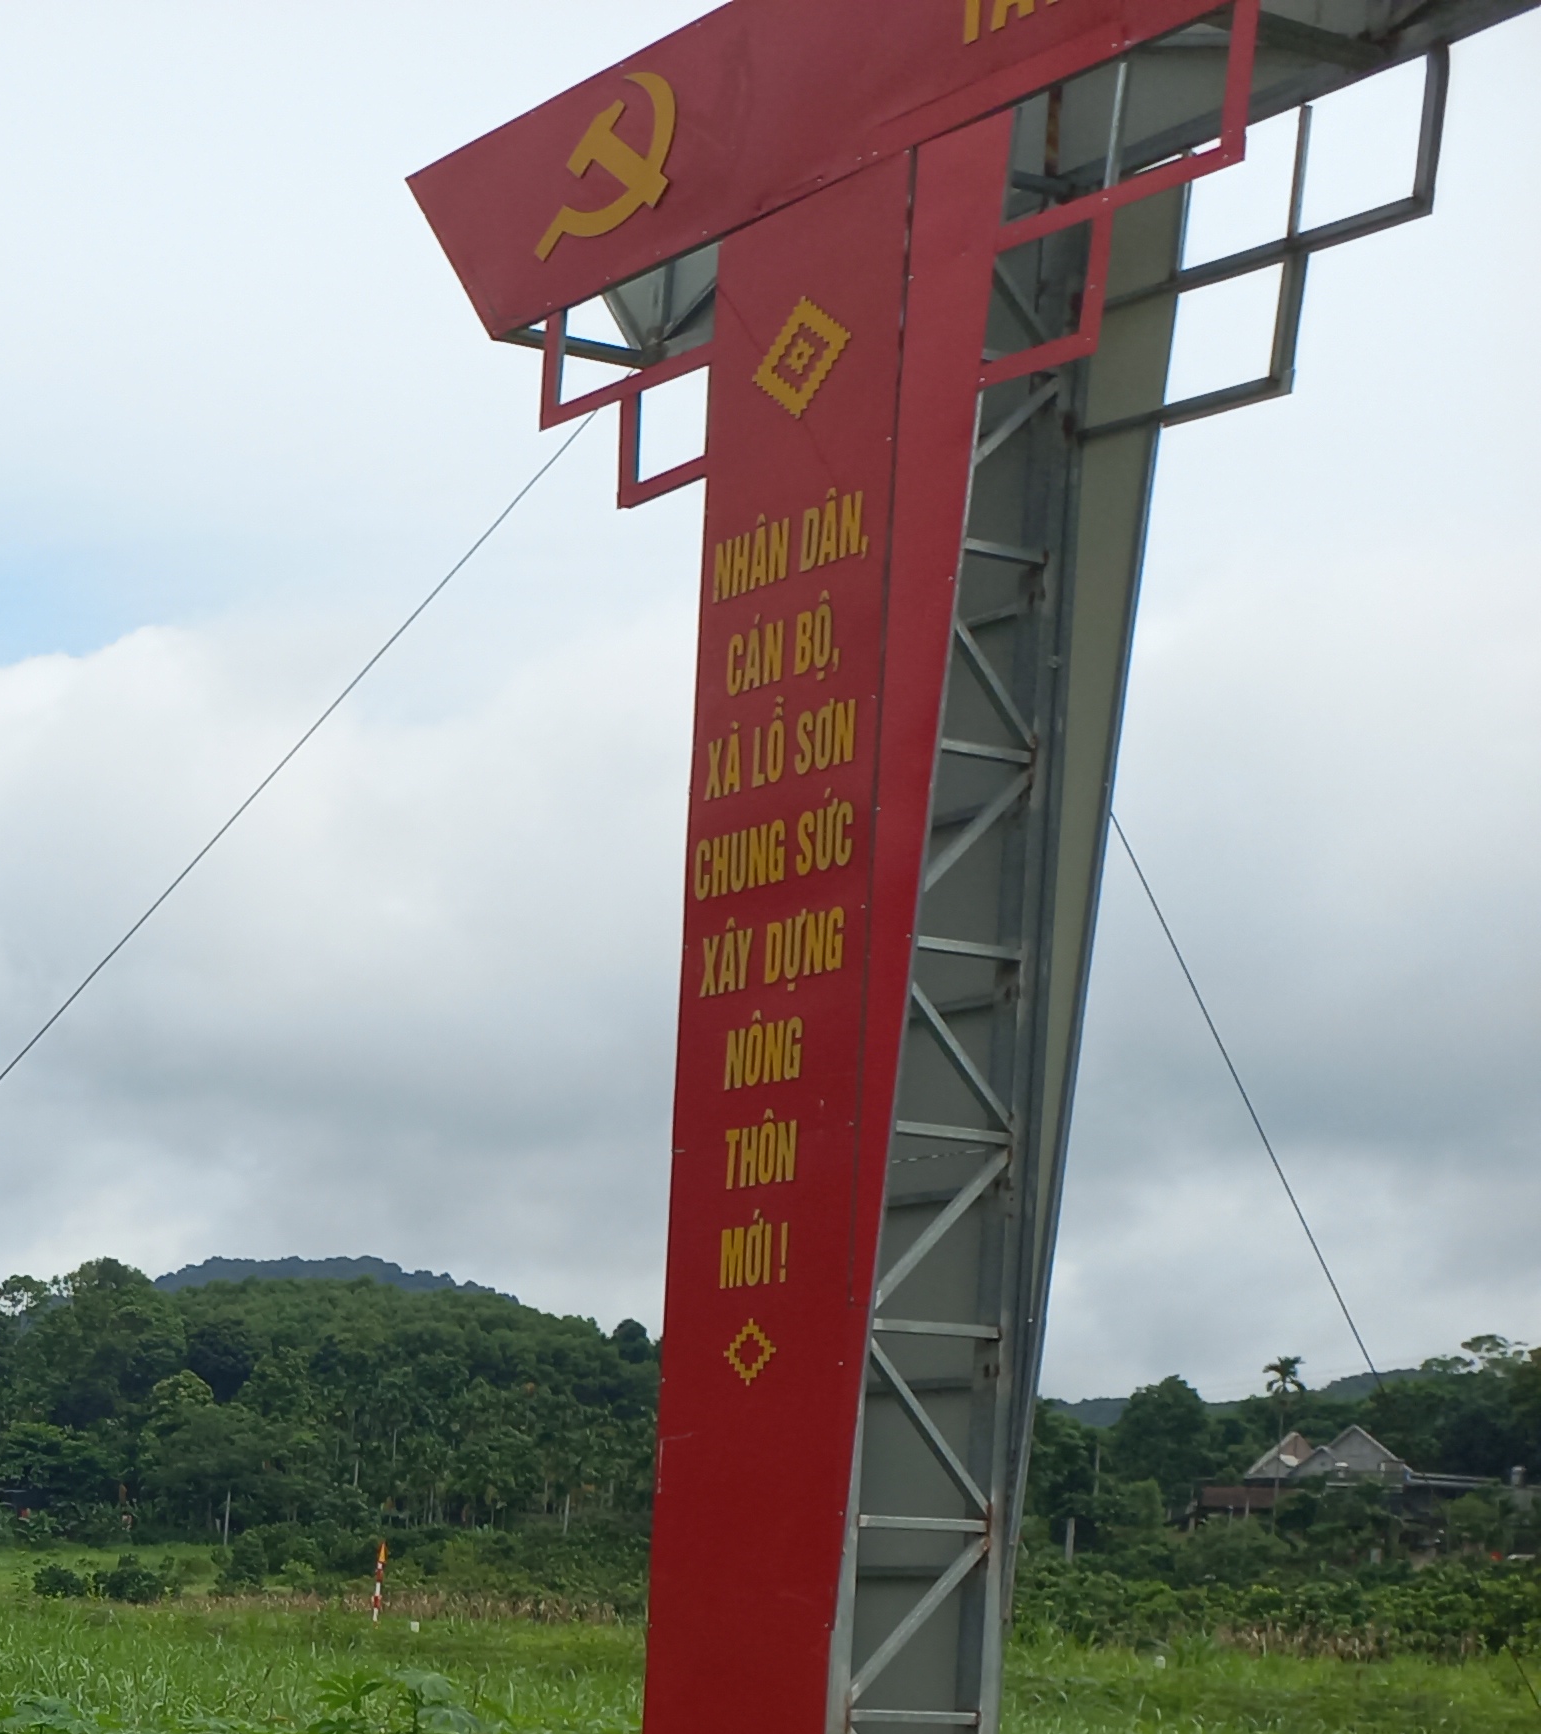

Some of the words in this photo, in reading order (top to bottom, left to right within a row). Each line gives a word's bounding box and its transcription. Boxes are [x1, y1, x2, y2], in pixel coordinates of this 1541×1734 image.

[713, 514, 790, 603] NHÂN
[799, 487, 869, 573] DÂN,
[726, 614, 784, 697] CÁN
[793, 590, 840, 681] BỘ,
[794, 697, 856, 775] SƠN
[694, 819, 786, 901] CHUNG
[795, 787, 853, 877] SỨC
[699, 917, 753, 998] XÂY
[764, 906, 844, 991] DỰNG
[724, 1010, 803, 1091] NÔNG
[725, 1108, 797, 1190] THÔN
